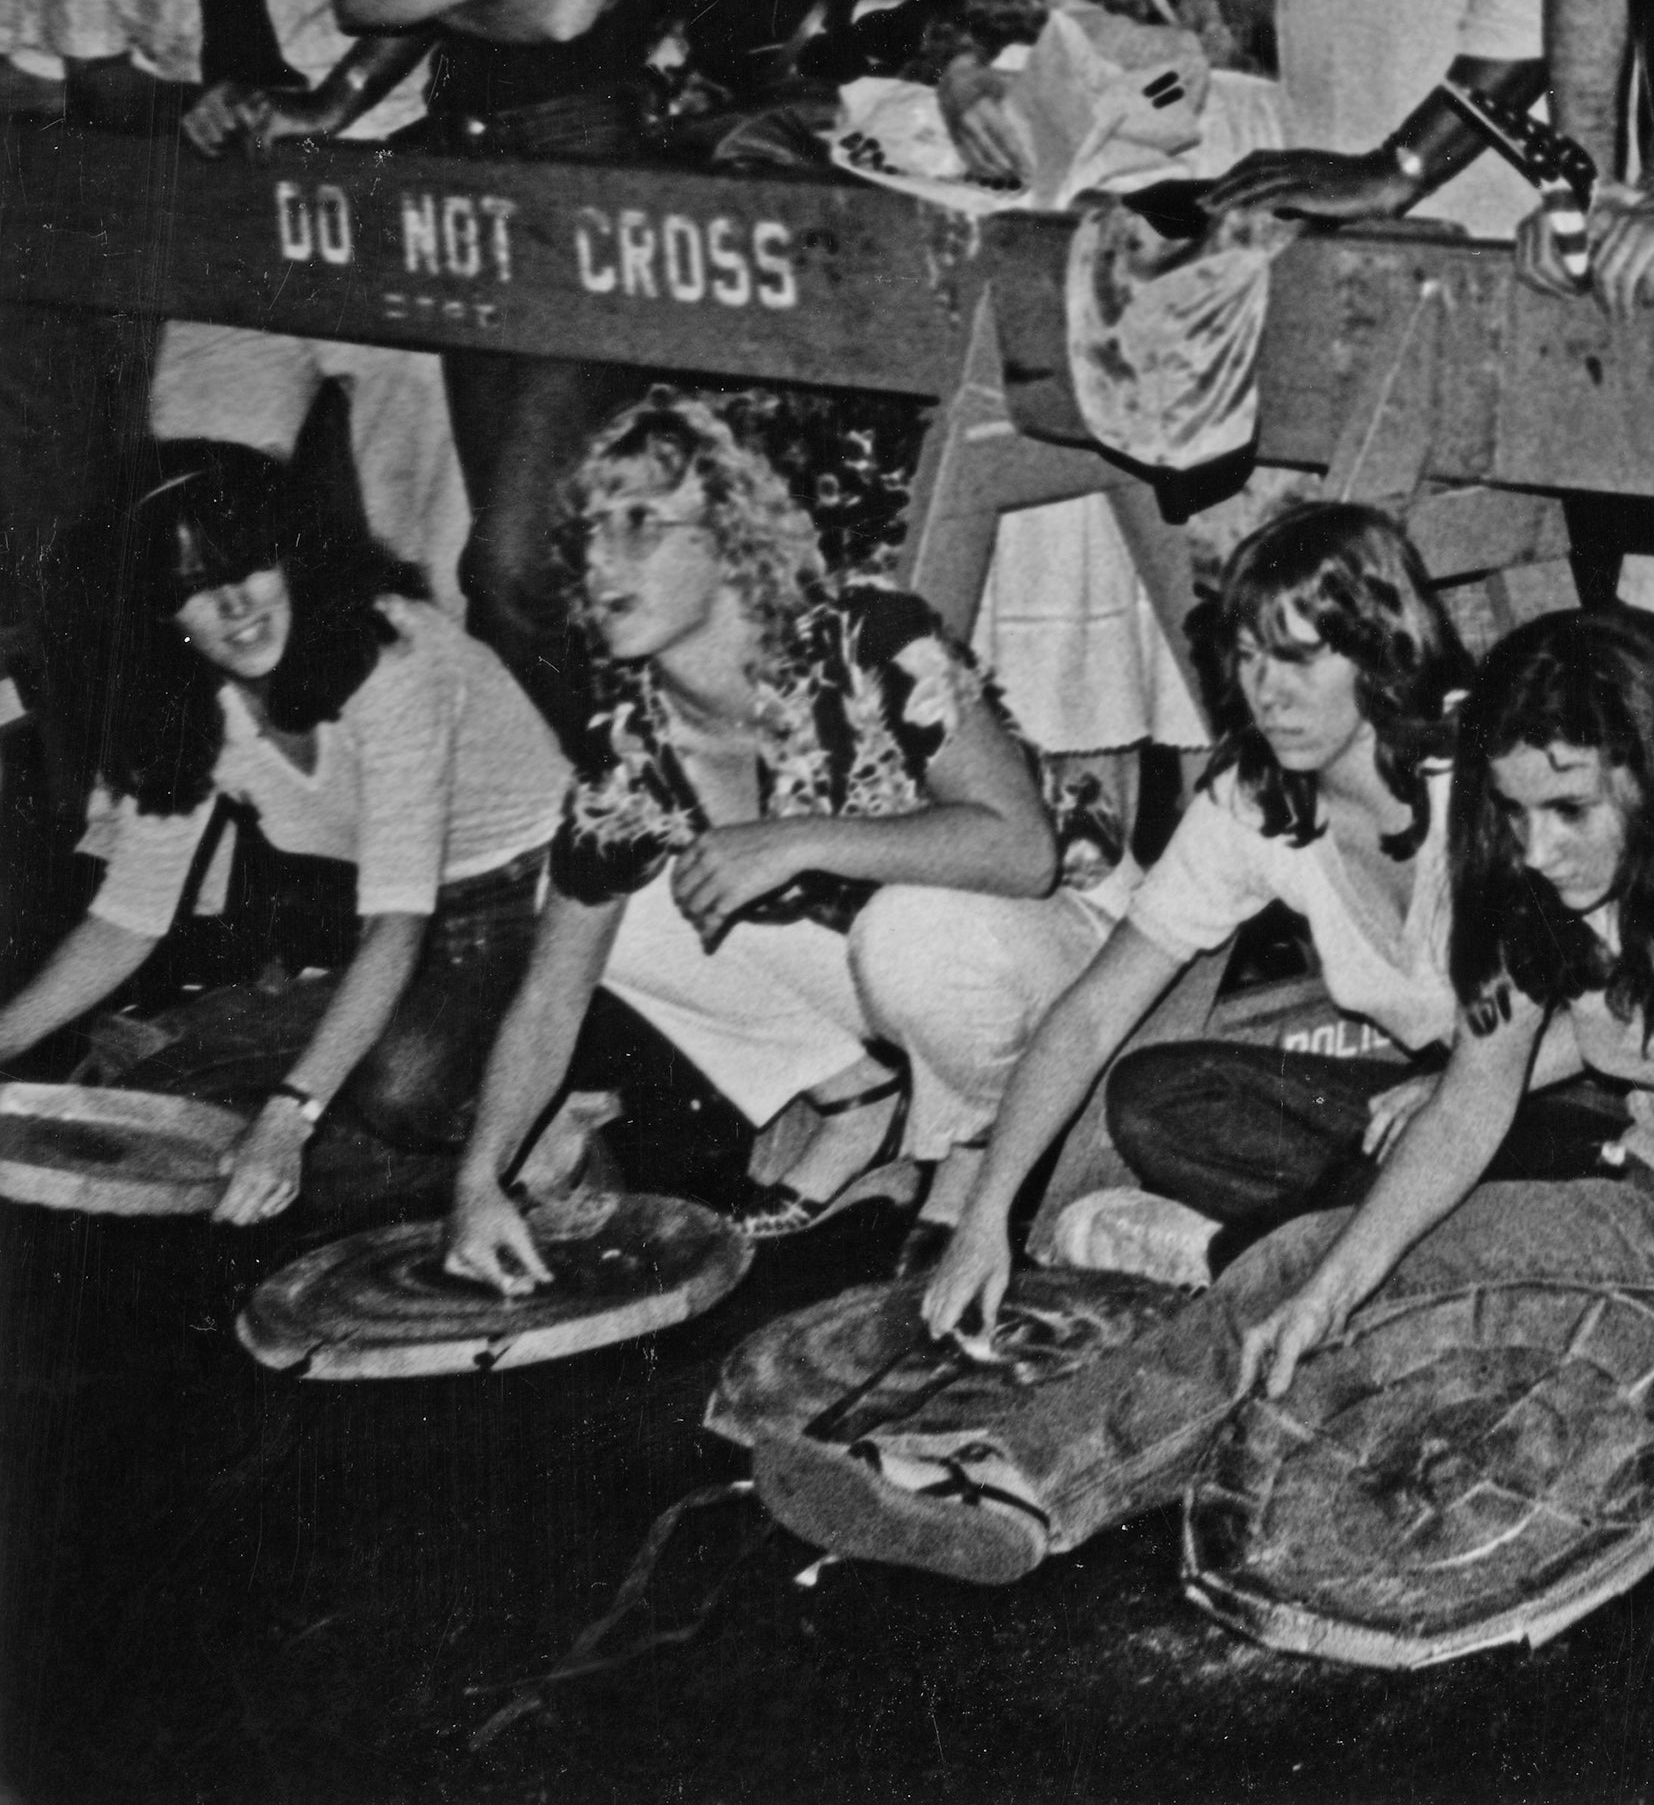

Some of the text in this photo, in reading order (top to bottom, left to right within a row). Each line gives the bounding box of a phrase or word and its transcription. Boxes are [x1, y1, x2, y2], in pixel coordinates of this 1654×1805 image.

[275, 180, 798, 311] DO NOT CROSS
